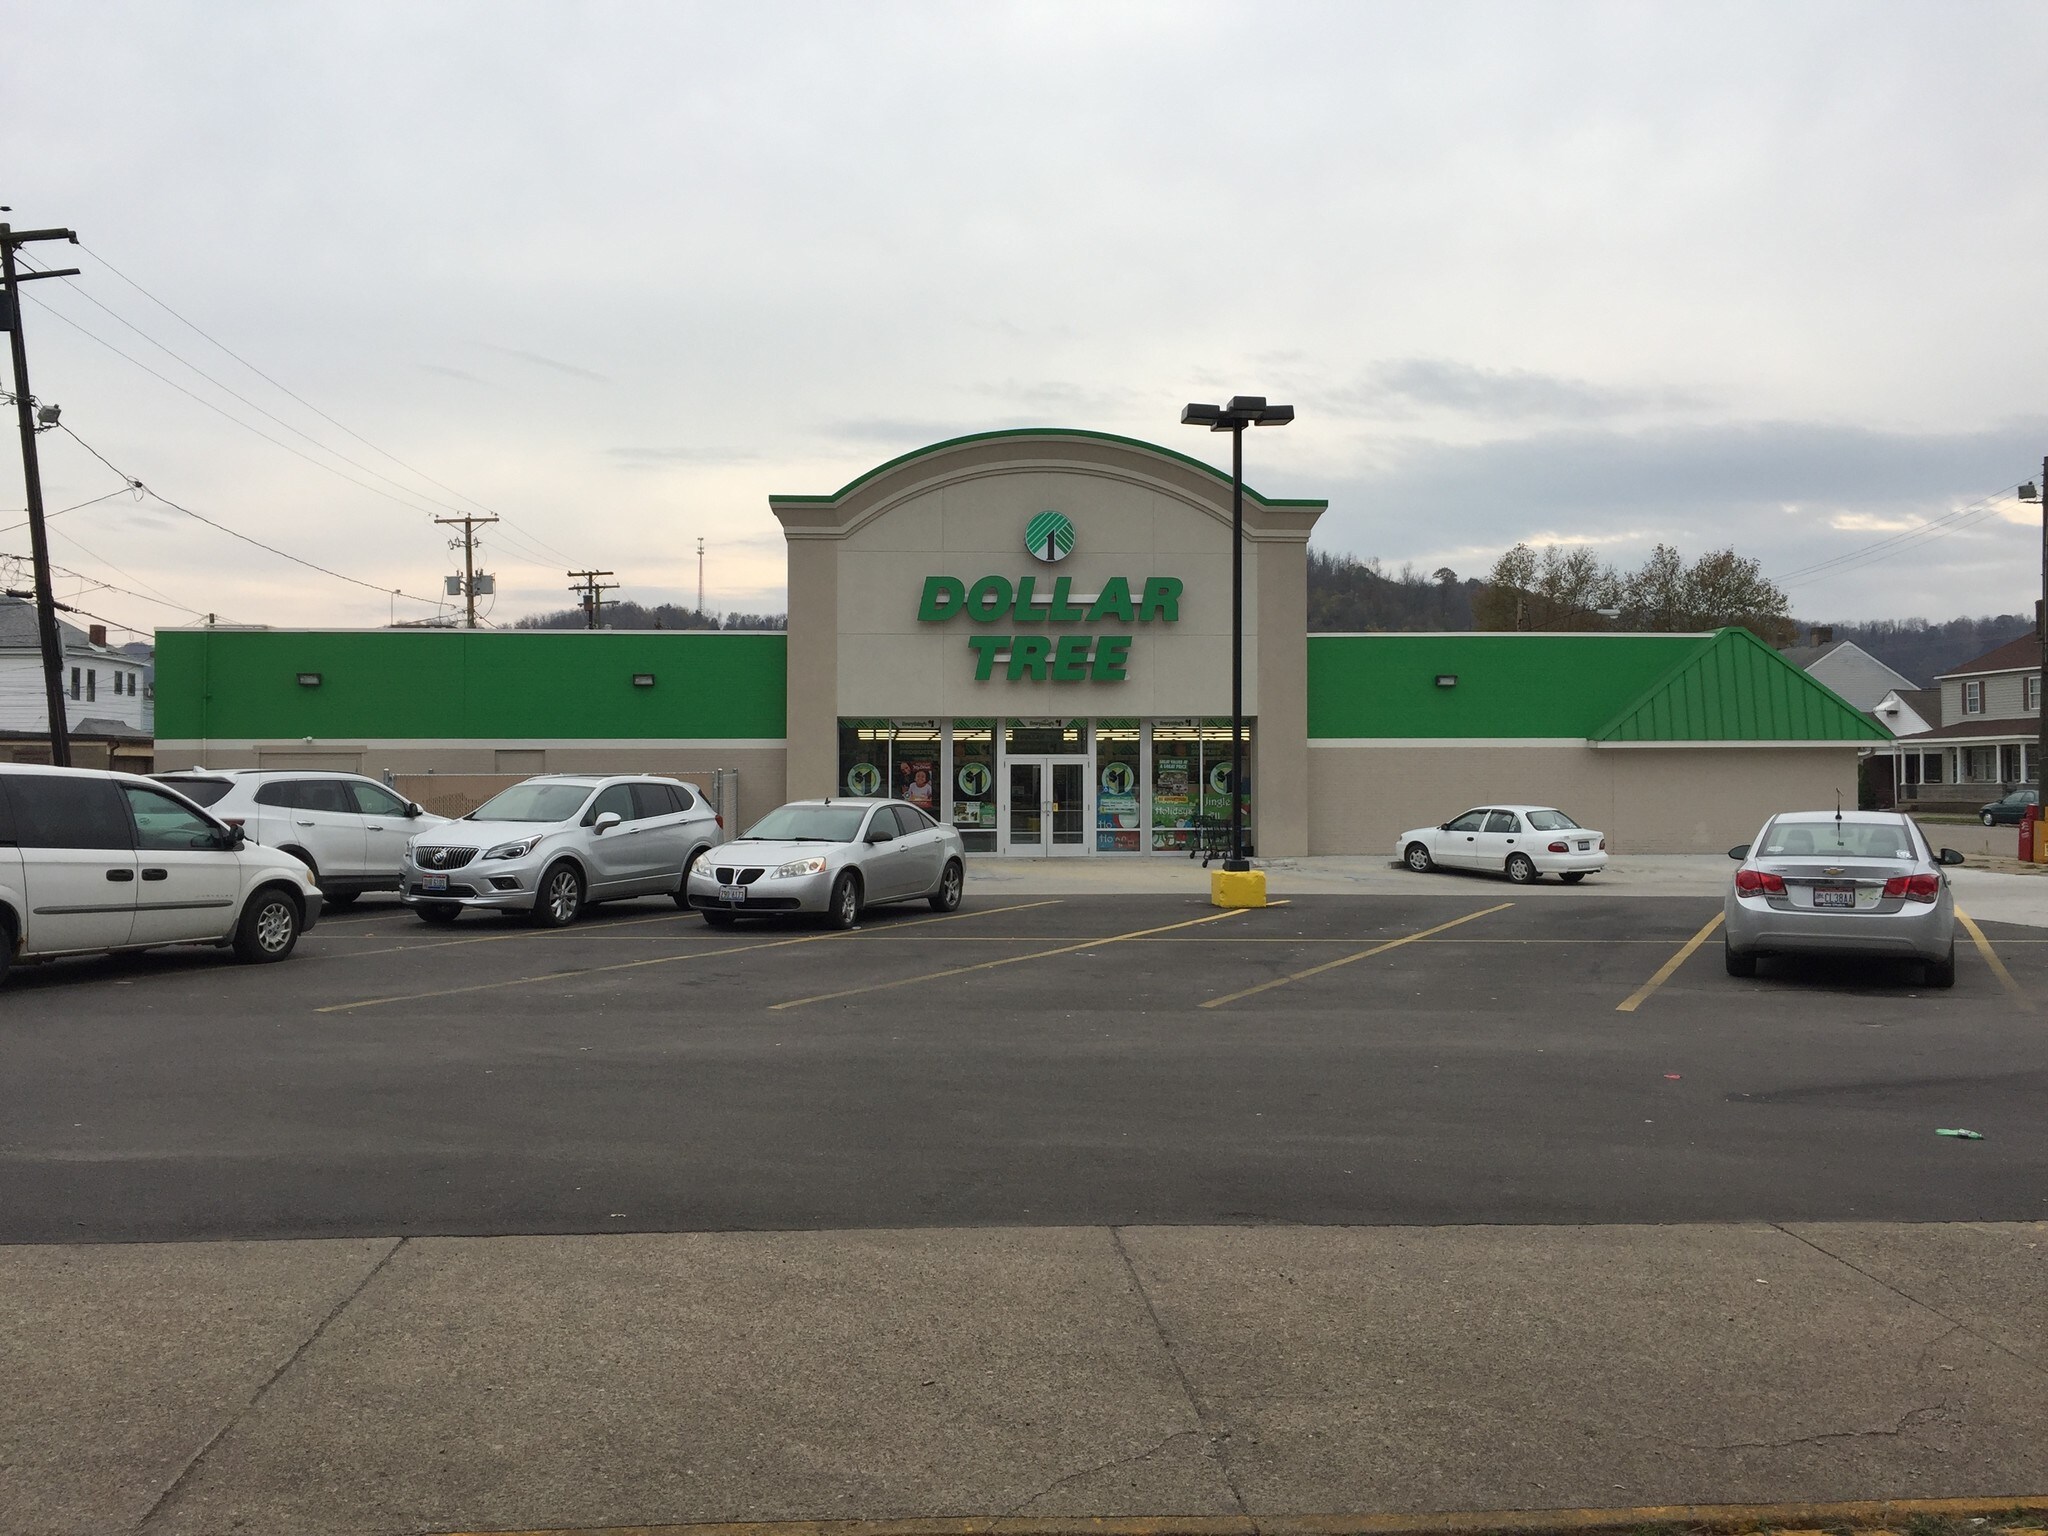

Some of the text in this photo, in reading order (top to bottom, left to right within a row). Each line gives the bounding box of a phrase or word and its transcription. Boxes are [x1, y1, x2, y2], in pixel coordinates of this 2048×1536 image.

[917, 575, 1184, 622] DOLLAR
[968, 636, 1133, 681] TREE
[1204, 797, 1231, 808] Jingle
[1155, 807, 1194, 816] Holidays
[1825, 892, 1853, 903] CL38AA
